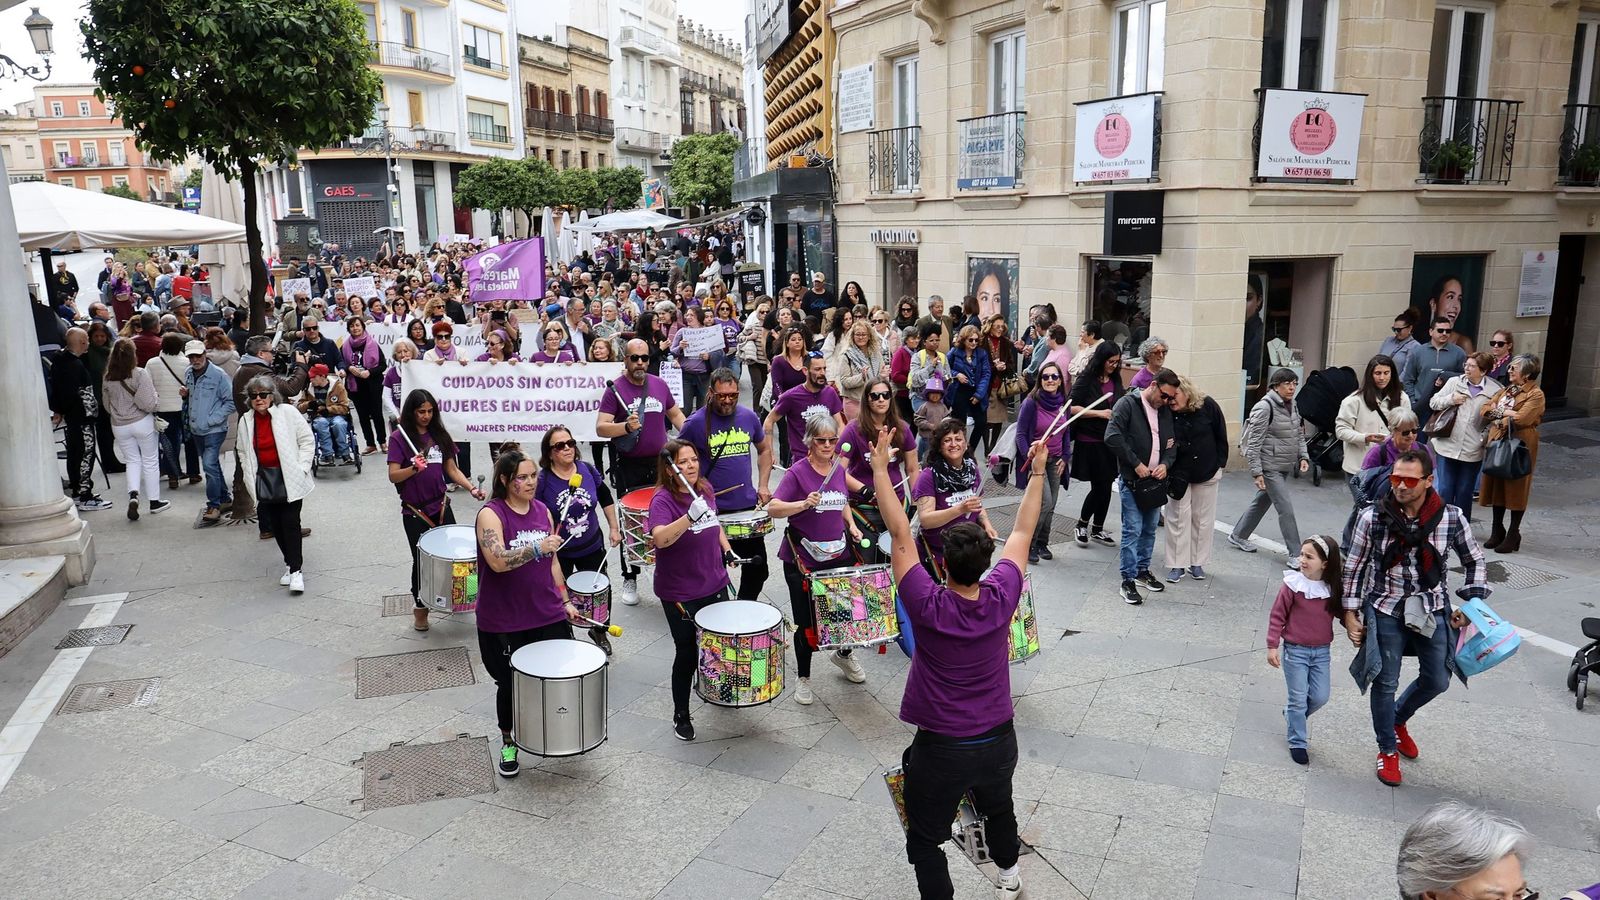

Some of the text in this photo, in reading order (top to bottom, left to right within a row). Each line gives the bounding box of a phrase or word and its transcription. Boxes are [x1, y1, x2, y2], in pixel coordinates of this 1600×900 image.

[966, 139, 1005, 153] ALGARVE
[1291, 168, 1303, 176] 657
[1304, 168, 1312, 176] 03
[185, 188, 195, 198] P
[324, 186, 355, 197] GAES
[1117, 217, 1156, 225] miramira
[378, 334, 395, 345] UN
[464, 333, 484, 346] MÁ
[441, 376, 606, 389] CUIDADOS SIN COTIZAR
[502, 399, 521, 412] EN
[466, 424, 506, 432] MUJERES
